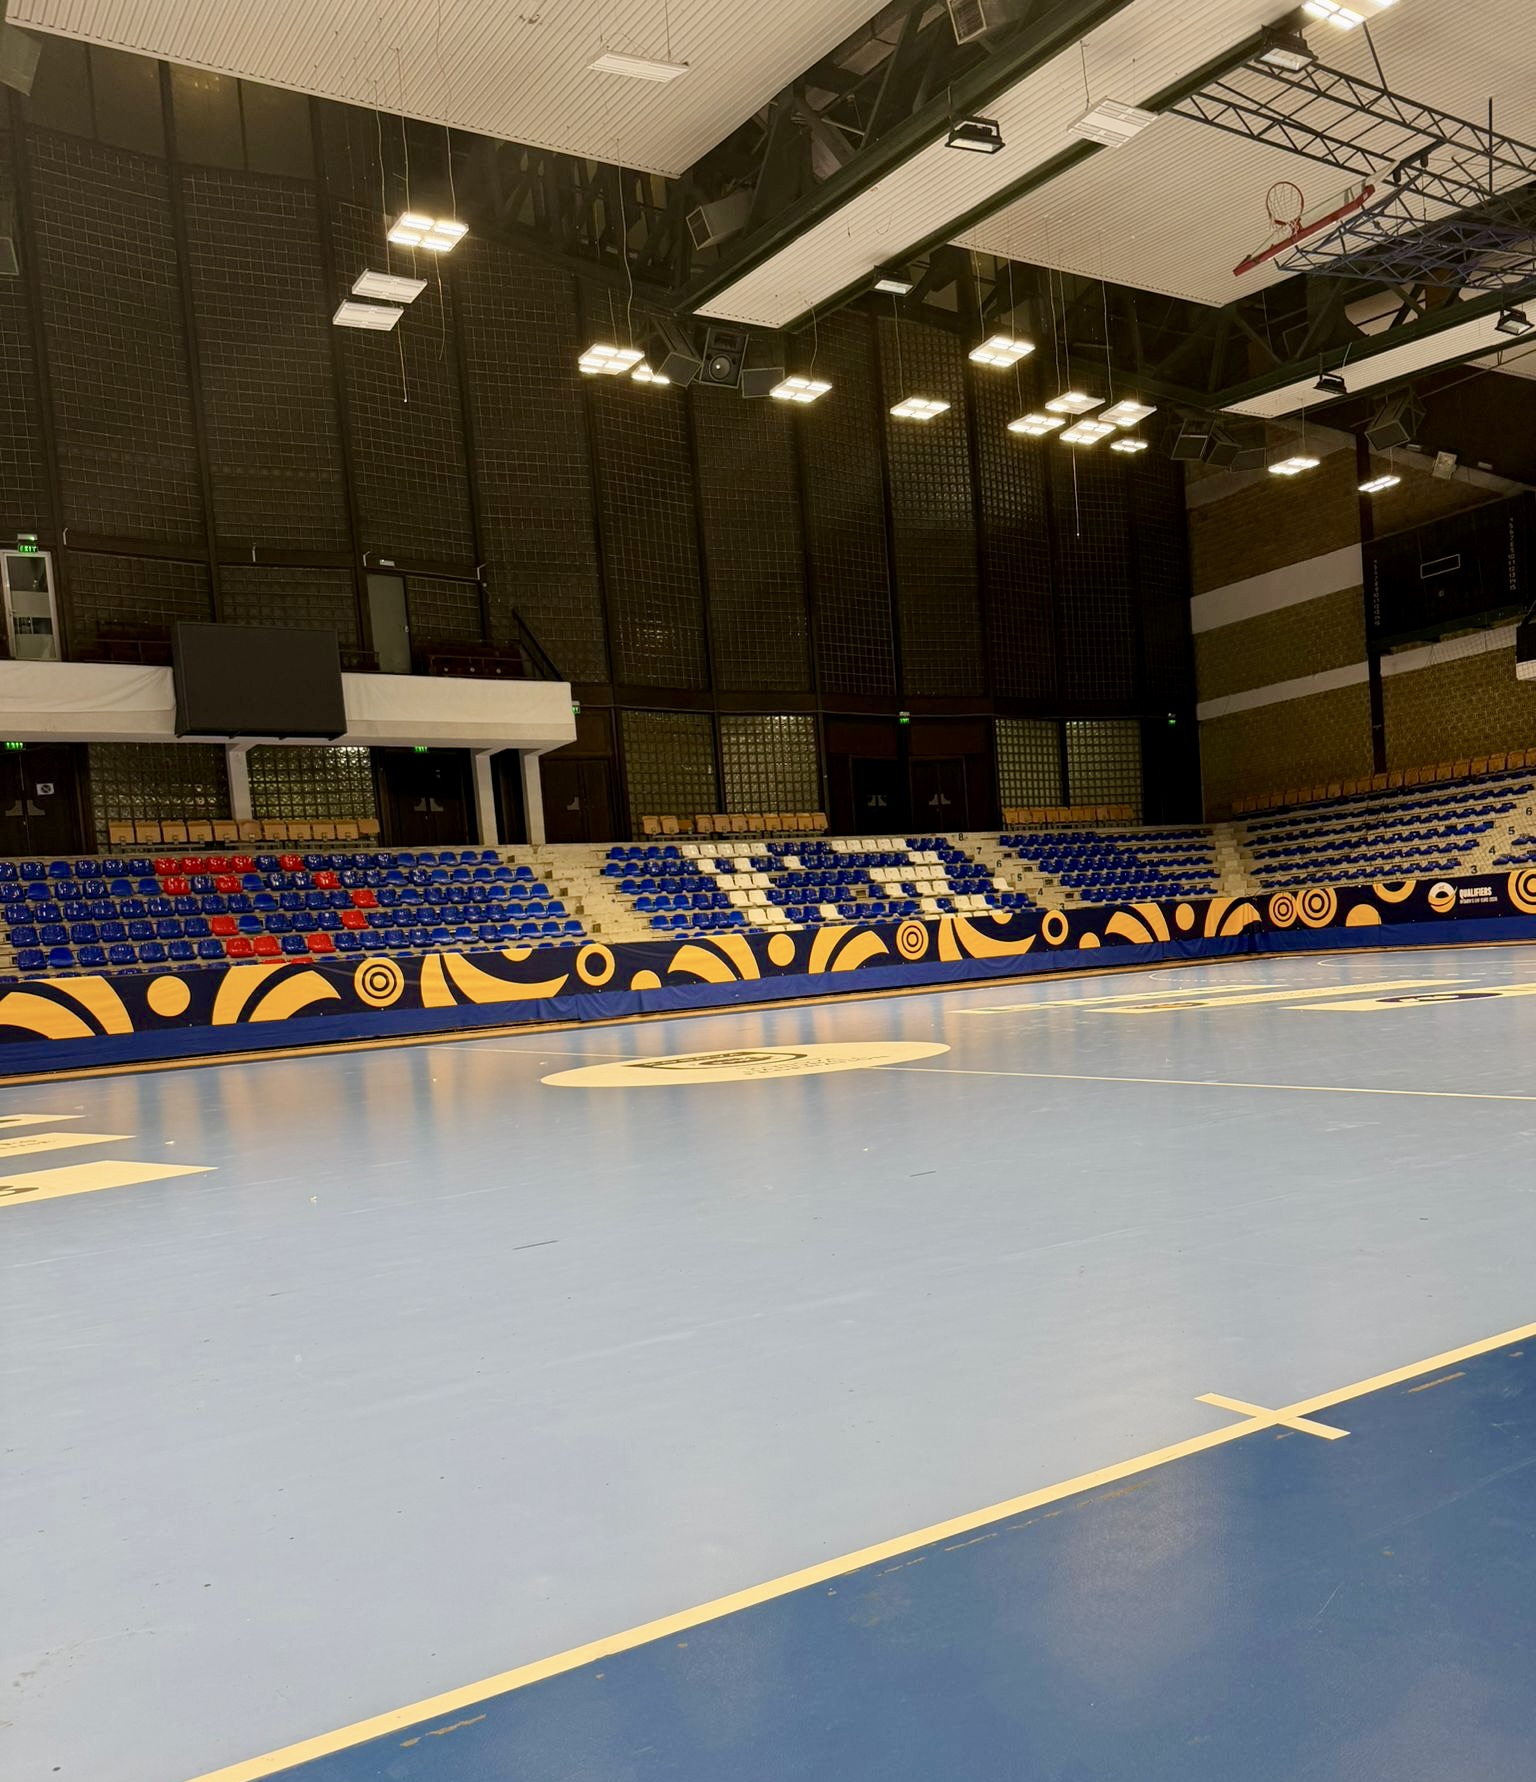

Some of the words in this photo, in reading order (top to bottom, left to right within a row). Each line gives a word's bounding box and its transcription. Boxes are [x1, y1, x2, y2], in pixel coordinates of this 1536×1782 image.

[1525, 807, 1533, 816] 6
[1508, 826, 1515, 835] 5
[958, 833, 964, 841] 8
[976, 847, 982, 855] 7
[1488, 845, 1496, 855] 4
[996, 860, 1002, 868] 6
[1470, 865, 1478, 874] 3
[1017, 873, 1023, 881] 5
[1038, 888, 1044, 896] 4
[1459, 887, 1492, 899] QUALIFIERS
